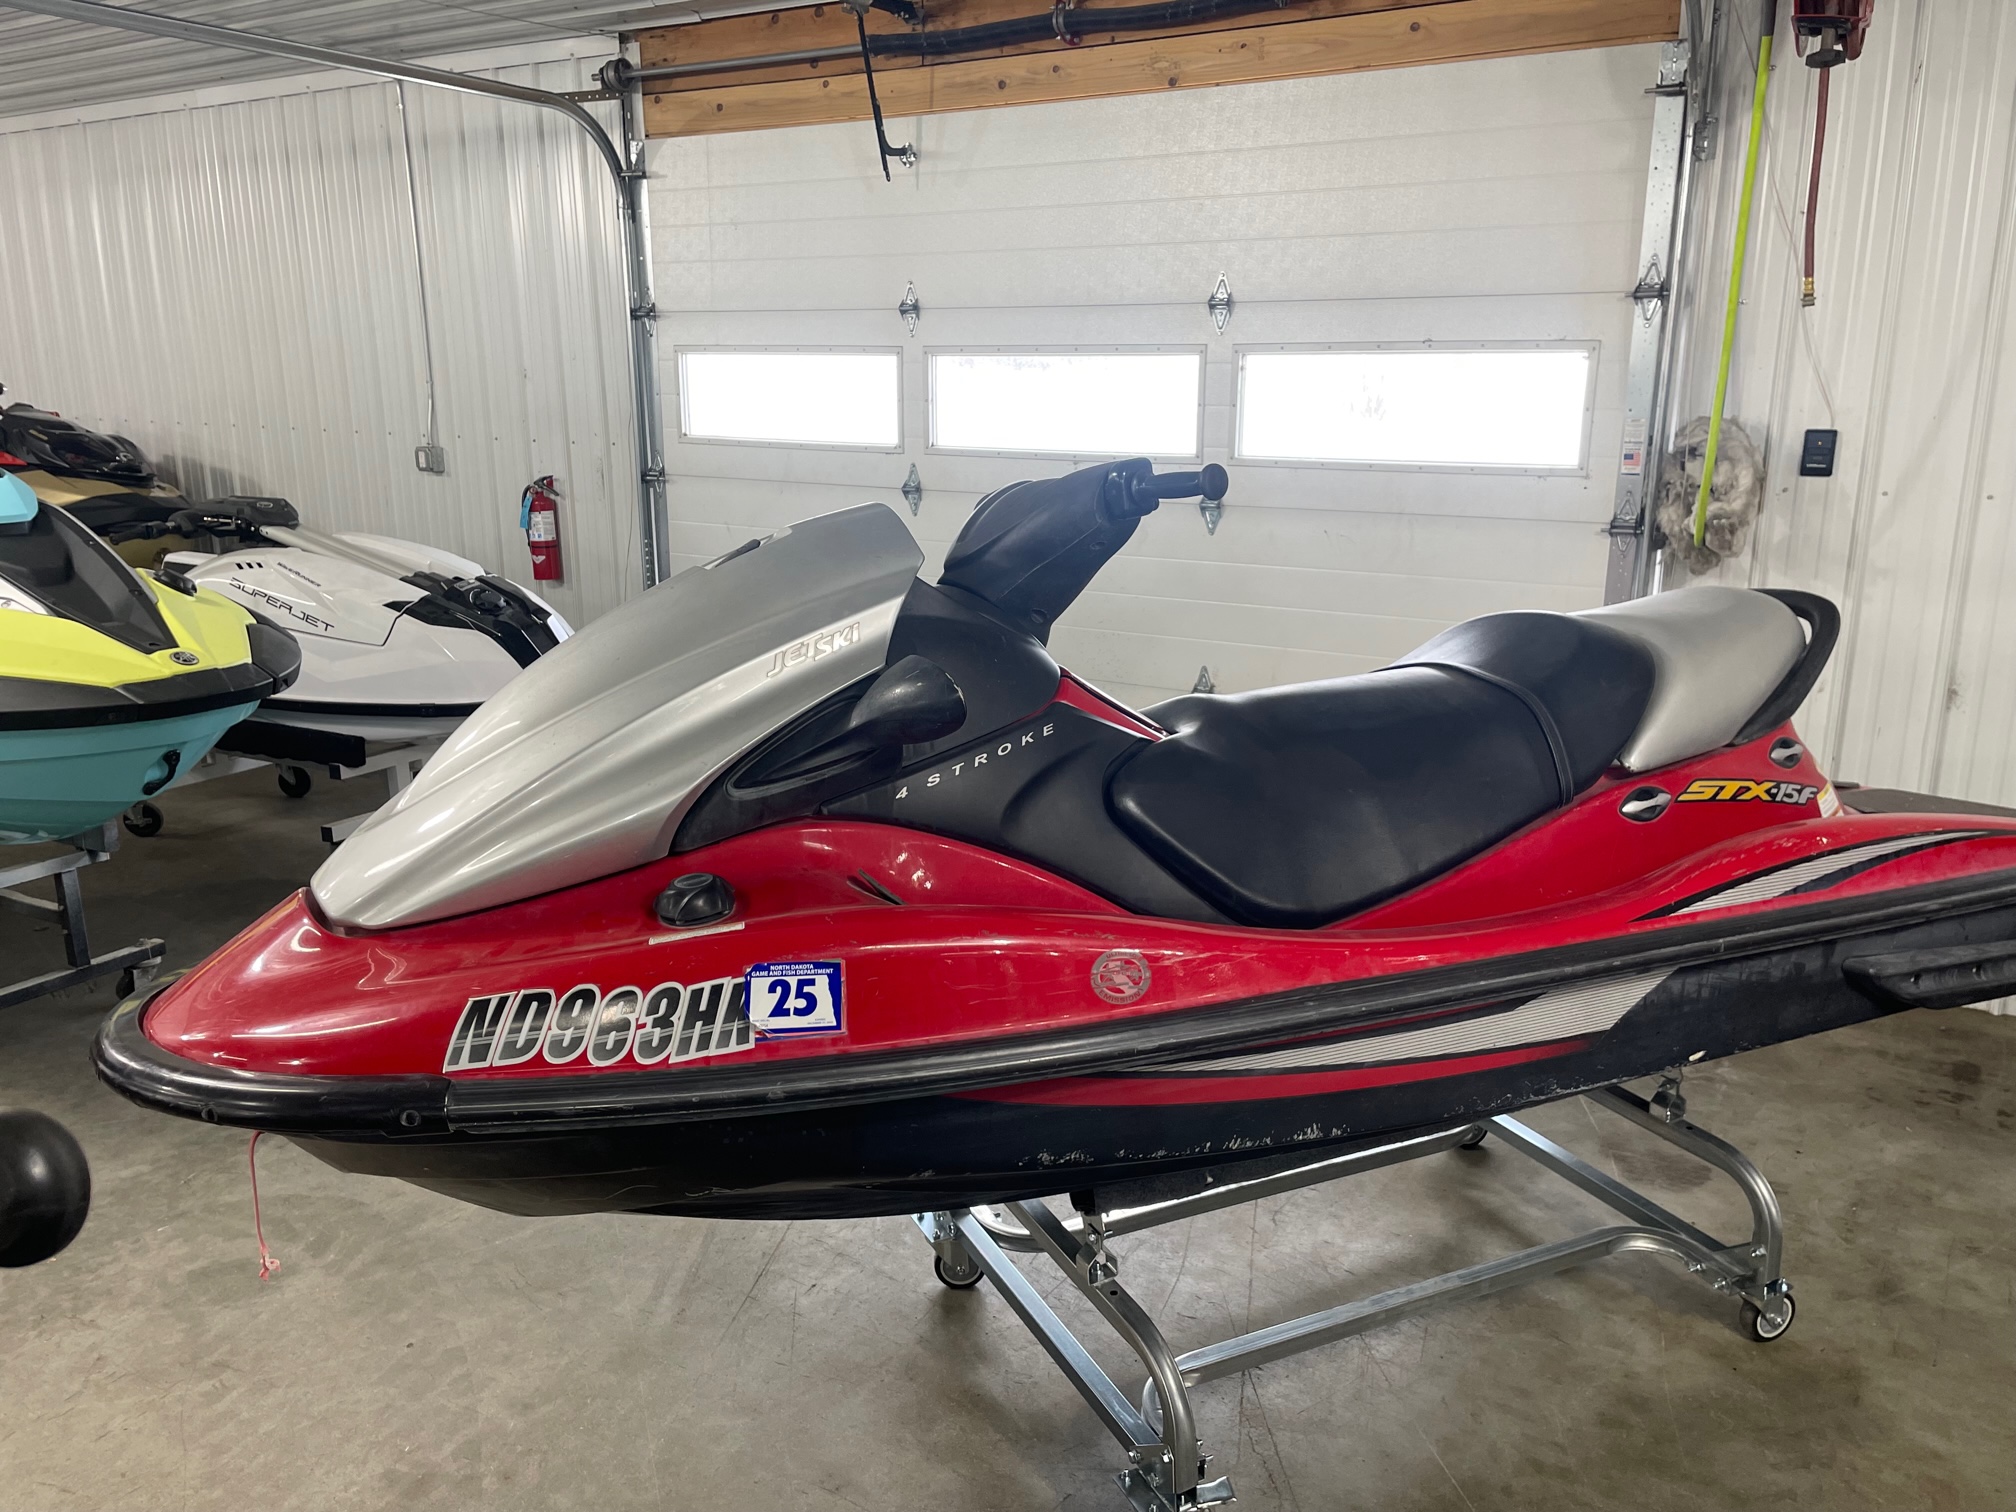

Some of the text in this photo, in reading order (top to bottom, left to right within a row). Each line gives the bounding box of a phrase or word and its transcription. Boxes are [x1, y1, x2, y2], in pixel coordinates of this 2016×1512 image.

[229, 577, 335, 632] SUPERJET
[895, 723, 1055, 800] 4 STROKE
[1676, 779, 1818, 805] STX-15F
[767, 977, 818, 1018] 25
